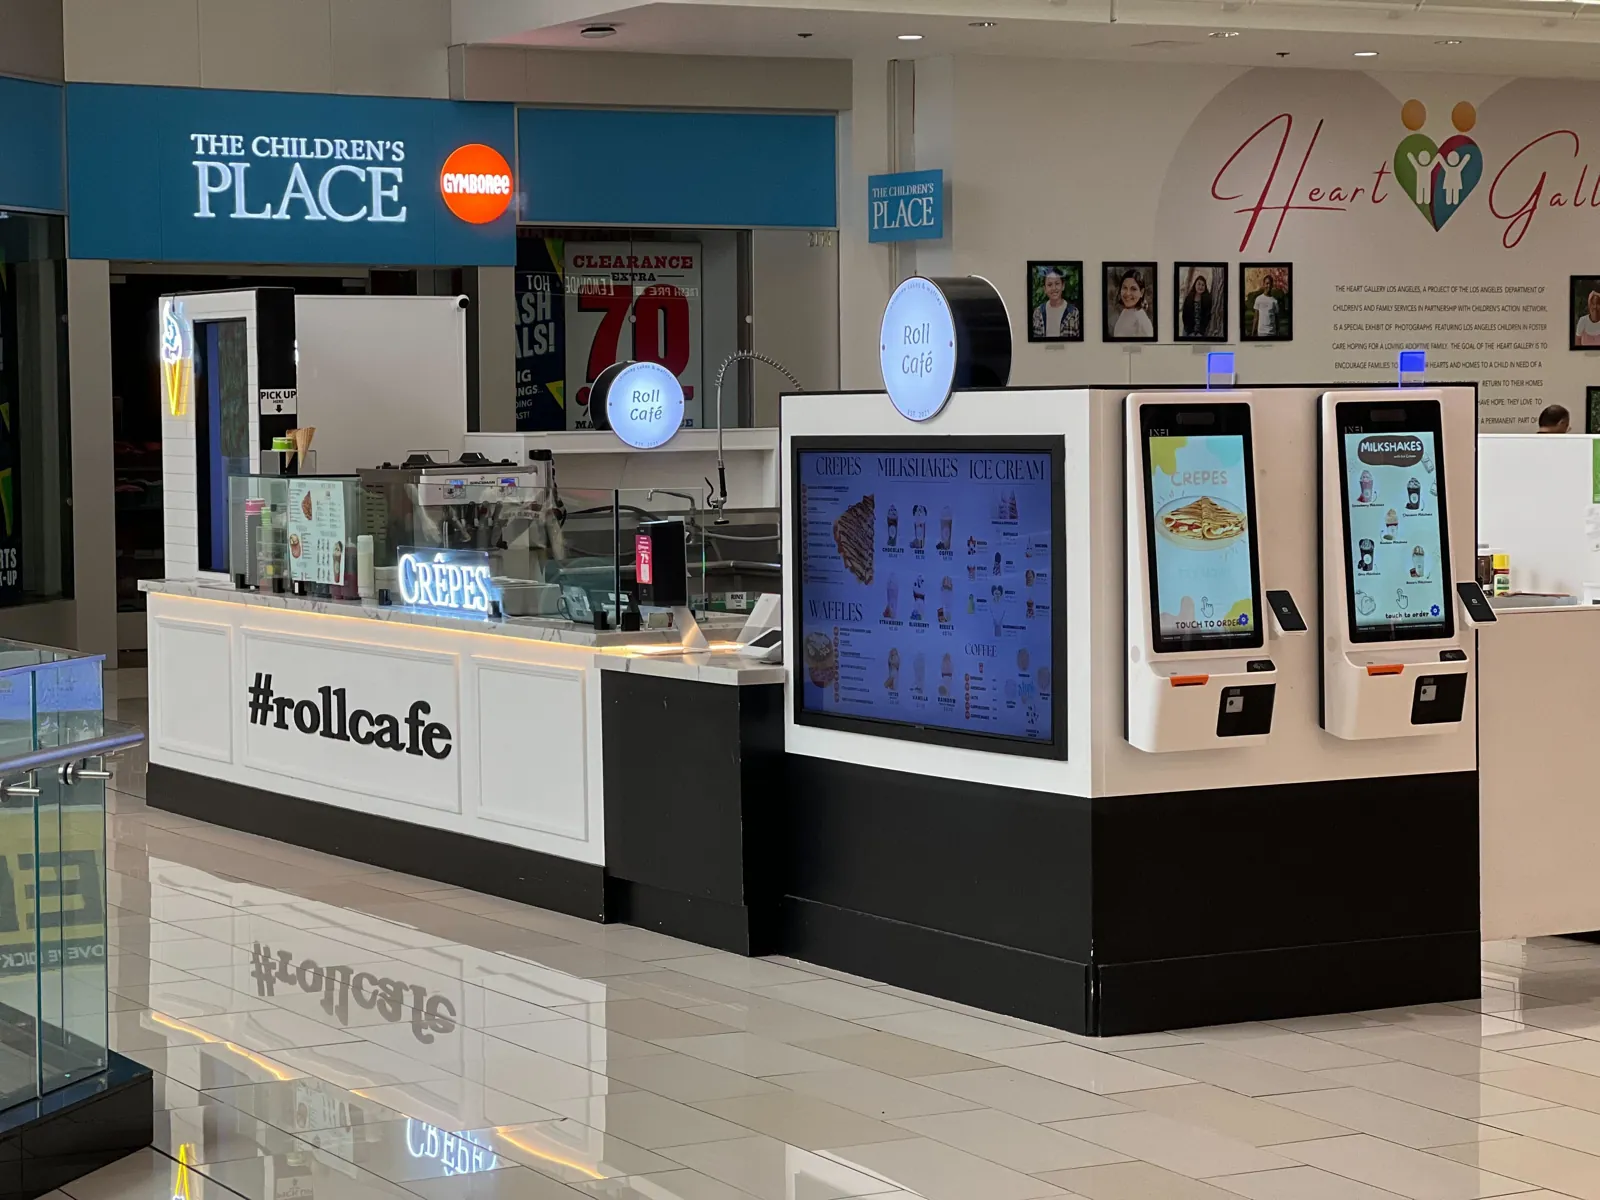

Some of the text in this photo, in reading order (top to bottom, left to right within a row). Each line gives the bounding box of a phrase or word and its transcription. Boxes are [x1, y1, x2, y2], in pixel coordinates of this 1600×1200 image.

[190, 133, 405, 162] THE CHILDREN'S
[192, 160, 407, 222] PLACE
[872, 183, 934, 198] THE CHILDREN'S
[1211, 113, 1392, 253] Heart
[872, 197, 934, 230] PLACE
[573, 255, 693, 269] CLEARANCE
[611, 272, 656, 282] EXTRA
[1335, 285, 1345, 293] THE
[1346, 285, 1363, 293] HEART
[1364, 285, 1386, 293] GALLERY
[1386, 285, 1396, 293] LOS
[1427, 285, 1450, 293] PROJECT
[1459, 285, 1469, 293] THE
[1469, 285, 1480, 293] LOS
[1480, 285, 1503, 293] ANGELES
[1504, 285, 1537, 293] DEPARTMENT
[1332, 304, 1362, 312] CHILDREN'S
[1363, 304, 1375, 312] AND
[1376, 304, 1393, 312] FAMILY
[1394, 304, 1417, 312] SERVICES
[1424, 304, 1458, 312] PARTNERSHIP
[1458, 304, 1471, 312] WITH
[1471, 304, 1500, 312] CHILDREN'S
[1501, 304, 1520, 312] ACTION
[577, 284, 690, 384] 70
[903, 322, 930, 345] Roll
[1344, 323, 1364, 331] SPECIAL
[1365, 323, 1384, 331] EXHIBIT
[1394, 323, 1432, 331] PHOTOGRAPHS
[1434, 323, 1462, 331] FEATURING
[1463, 323, 1473, 331] LOS
[1474, 323, 1496, 331] ANGELES
[1497, 323, 1522, 331] CHILDREN
[1529, 323, 1547, 331] FOSTER
[1332, 342, 1346, 350] CARE
[1346, 342, 1367, 350] HOPING
[1368, 342, 1379, 350] FOR
[1384, 342, 1404, 350] LOVING
[1450, 342, 1460, 350] THE
[1461, 342, 1476, 350] GOAL
[1484, 342, 1494, 350] THE
[1496, 342, 1513, 350] HEART
[1513, 342, 1534, 350] GALLERY
[902, 350, 933, 378] Café
[1334, 361, 1367, 369] ENCOURAGE
[1368, 361, 1390, 369] FAMILIES
[1430, 361, 1449, 369] HEARTS
[1450, 361, 1462, 369] AND
[1462, 361, 1480, 369] HOMES
[1494, 361, 1509, 369] CHILD
[1516, 361, 1529, 369] NEED
[260, 390, 297, 400] PICK UP
[632, 389, 660, 403] Roll
[1507, 398, 1519, 406] THEY
[1520, 398, 1532, 406] LOVE
[630, 405, 663, 422] Café
[815, 456, 862, 476] CREPES
[877, 457, 958, 478] MILKSHAKES
[969, 459, 1045, 481] ICE CREAM
[1170, 470, 1228, 486] CREPES
[398, 552, 491, 612] CRÊPES
[808, 600, 864, 622] WAFFLES
[1412, 610, 1429, 618] order
[1175, 620, 1202, 629] TOUCH
[1204, 620, 1214, 628] TO
[964, 642, 998, 658] COFFEE
[248, 671, 452, 759] #rollcafe
